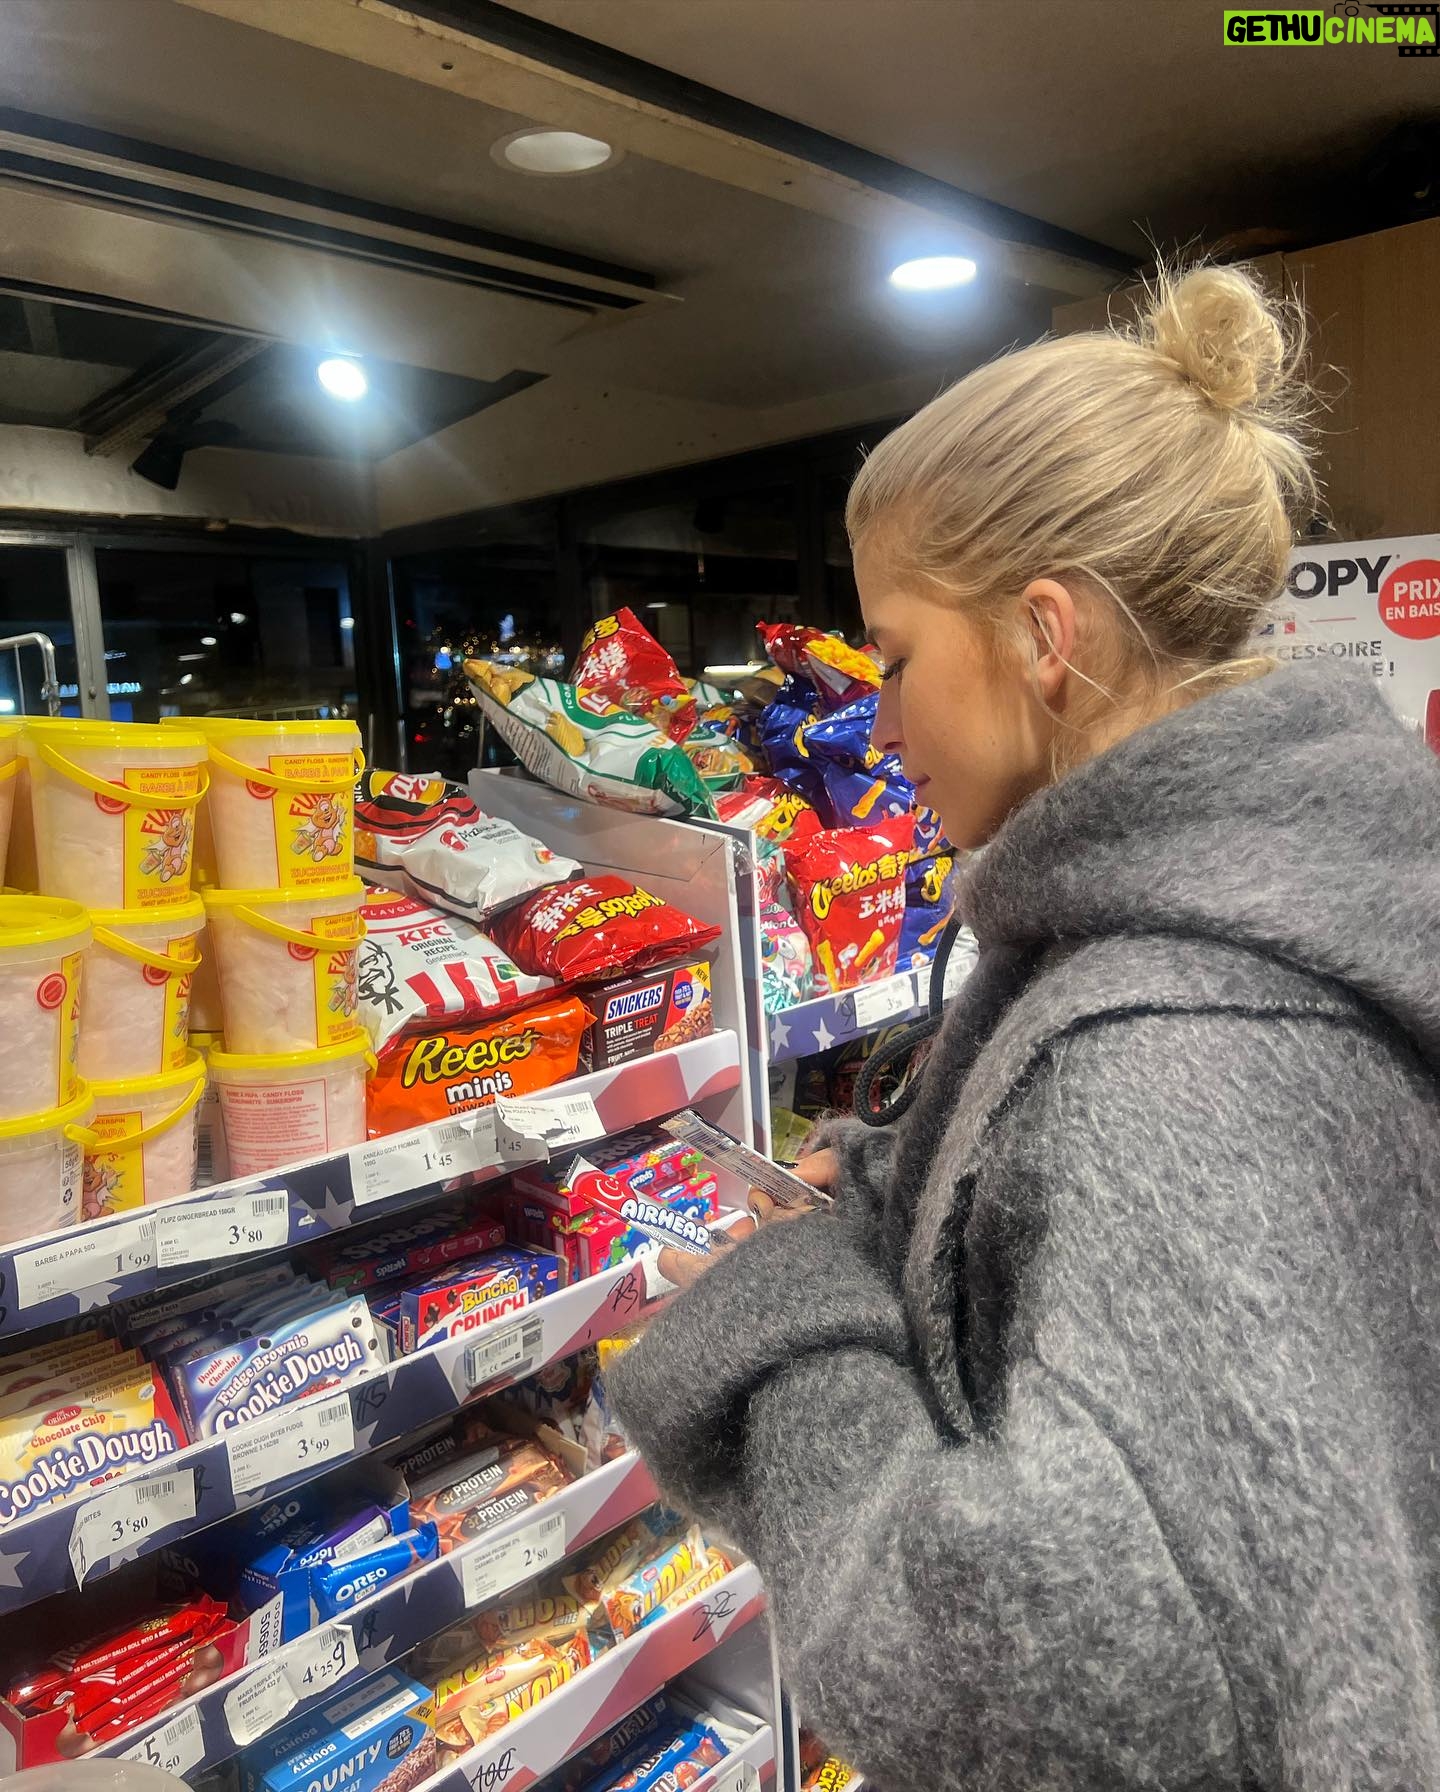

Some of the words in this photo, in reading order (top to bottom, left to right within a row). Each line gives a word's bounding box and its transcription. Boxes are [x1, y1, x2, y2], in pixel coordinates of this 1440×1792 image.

[1386, 606, 1404, 620] EN
[810, 861, 878, 920] Cheetos
[396, 925, 452, 946] KFC
[411, 937, 456, 952] ORIGINAL
[424, 944, 458, 956] RECIPE
[426, 951, 470, 966] Geschmack
[696, 968, 708, 982] NEW
[608, 986, 662, 1020] SNICKERS
[604, 1022, 634, 1038] TRIPLE
[634, 1014, 658, 1028] TREAT
[403, 1028, 537, 1087] Reese's
[263, 1090, 282, 1098] CANDY
[446, 1071, 512, 1103] minis
[449, 1093, 516, 1115] UNWRAED
[363, 1149, 384, 1160] ANNEAU
[384, 1145, 398, 1154] GOUT
[398, 1138, 420, 1150] FROMAGE
[160, 1215, 176, 1224] FLIPZ
[176, 1210, 218, 1222] GINGERBREAD
[620, 1198, 714, 1248] AIRHEAD
[35, 1253, 58, 1268] BARBE
[66, 1247, 83, 1257] PAPA
[461, 1276, 518, 1313] Buncha
[131, 1310, 160, 1322] Nutrition
[160, 1303, 178, 1314] Facts
[198, 1358, 223, 1385] Double
[208, 1354, 241, 1387] Chocolate
[216, 1366, 256, 1407] Fudge
[254, 1334, 309, 1372] Brownie
[48, 1409, 78, 1425] ORIGINAL
[31, 1424, 80, 1448] Chocolate
[82, 1413, 106, 1428] Chip
[232, 1442, 253, 1453] COOKIE
[270, 1428, 286, 1440] BITES
[286, 1421, 304, 1432] FUDGE
[232, 1448, 258, 1460] BROWNIE
[408, 1437, 456, 1470] PROTEIN
[452, 1464, 504, 1497] PROTEIN
[83, 1510, 102, 1525] BITES
[478, 1490, 528, 1522] PROTEIN
[335, 1567, 388, 1603] OREO
[644, 1543, 693, 1612] LION
[356, 1585, 376, 1600] cake
[512, 1595, 578, 1628] LION
[552, 1612, 578, 1627] WHITE
[112, 1646, 128, 1657] BALLS
[128, 1640, 140, 1651] ROLL
[140, 1635, 154, 1645] INTO
[147, 1657, 158, 1668] BALLS
[158, 1650, 168, 1660] ROLL
[168, 1644, 180, 1655] INTO
[152, 1676, 165, 1686] BALLS
[165, 1668, 176, 1679] ROLL
[176, 1662, 185, 1672] INTO
[238, 1686, 254, 1702] MARS
[254, 1674, 272, 1690] TRIPLE
[272, 1662, 289, 1678] TREAT
[416, 1704, 432, 1719] NEW
[274, 1726, 319, 1757] BOUNTY
[292, 1742, 337, 1774] BOUNTY
